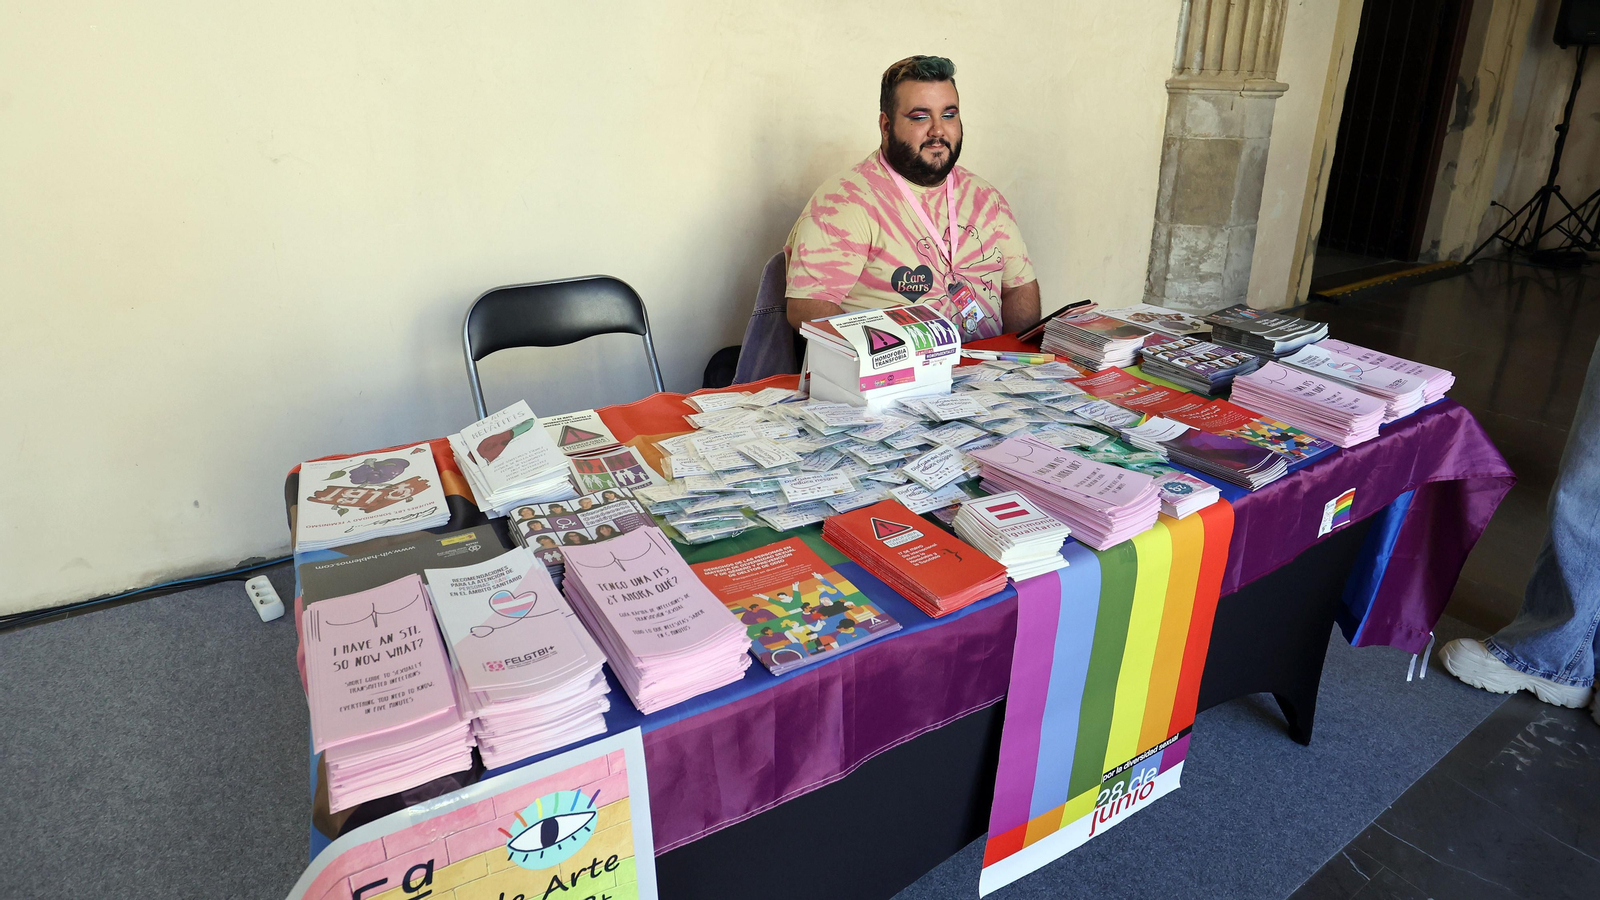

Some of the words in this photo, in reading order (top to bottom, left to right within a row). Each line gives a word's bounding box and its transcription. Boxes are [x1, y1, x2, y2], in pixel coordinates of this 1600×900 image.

[897, 281, 930, 292] Bears
[903, 270, 926, 284] Care
[874, 348, 907, 362] HOMOFOBIA
[875, 354, 907, 367] TRANSFOBIA
[471, 411, 525, 439] HEPATITIS
[566, 438, 606, 449] HOMOFOBIA
[1046, 461, 1060, 470] UNA
[407, 501, 435, 511] MUJERES
[352, 512, 392, 522] SORORIDAD
[1000, 518, 1055, 533] matrimonio
[1008, 522, 1062, 537] igualitario
[314, 545, 416, 570] www.vih-hablemos.com
[704, 563, 734, 572] DERECHOS
[754, 548, 783, 560] PERSONAS
[704, 567, 731, 575] MATERIA
[740, 555, 775, 568] DIVERSIDAD
[775, 548, 796, 557] SEXUAL
[728, 564, 751, 574] GÉNERO
[756, 552, 793, 567] PREVENCIÓN
[451, 565, 508, 583] RECOMENDACIONES
[476, 571, 505, 584] ATENCIÓN
[596, 581, 628, 592] TENGO
[630, 575, 652, 587] UNA
[652, 566, 669, 578] ITS
[736, 565, 760, 575] DELITOS
[458, 582, 491, 592] PERSONAS
[468, 586, 492, 595] ÁMBITO
[492, 575, 523, 590] SANITARIO
[607, 594, 618, 605] ¿Y
[621, 588, 654, 602] AHORA
[654, 576, 678, 593] QUÉ?
[656, 597, 684, 610] INFECCIONES
[665, 604, 684, 615] SEXUAL
[664, 617, 689, 630] NECESITAS
[689, 609, 705, 619] SABER
[671, 625, 691, 636] MINUTOS
[333, 647, 336, 656] I
[342, 639, 372, 655] HAVE
[379, 633, 393, 646] AN
[333, 659, 349, 672] SO
[355, 653, 380, 667] NOW
[386, 638, 423, 659] WHAT?
[504, 645, 555, 666] FELGTBI+
[344, 679, 362, 687] SHORT
[392, 662, 422, 676] SEXUALLY
[349, 681, 387, 694] TRANSMITTED
[390, 671, 421, 685] INFECTIONS
[339, 699, 375, 712] EVERYTHING
[391, 691, 406, 699] NEED
[389, 697, 414, 709] MINUTES
[1102, 770, 1115, 783] por
[1116, 766, 1123, 775] la
[1124, 745, 1158, 770] diversidad
[1158, 733, 1180, 750] sexual
[1096, 780, 1125, 808] 28
[1128, 766, 1158, 792] de
[1088, 780, 1155, 837] junio
[541, 854, 619, 900] Arte
